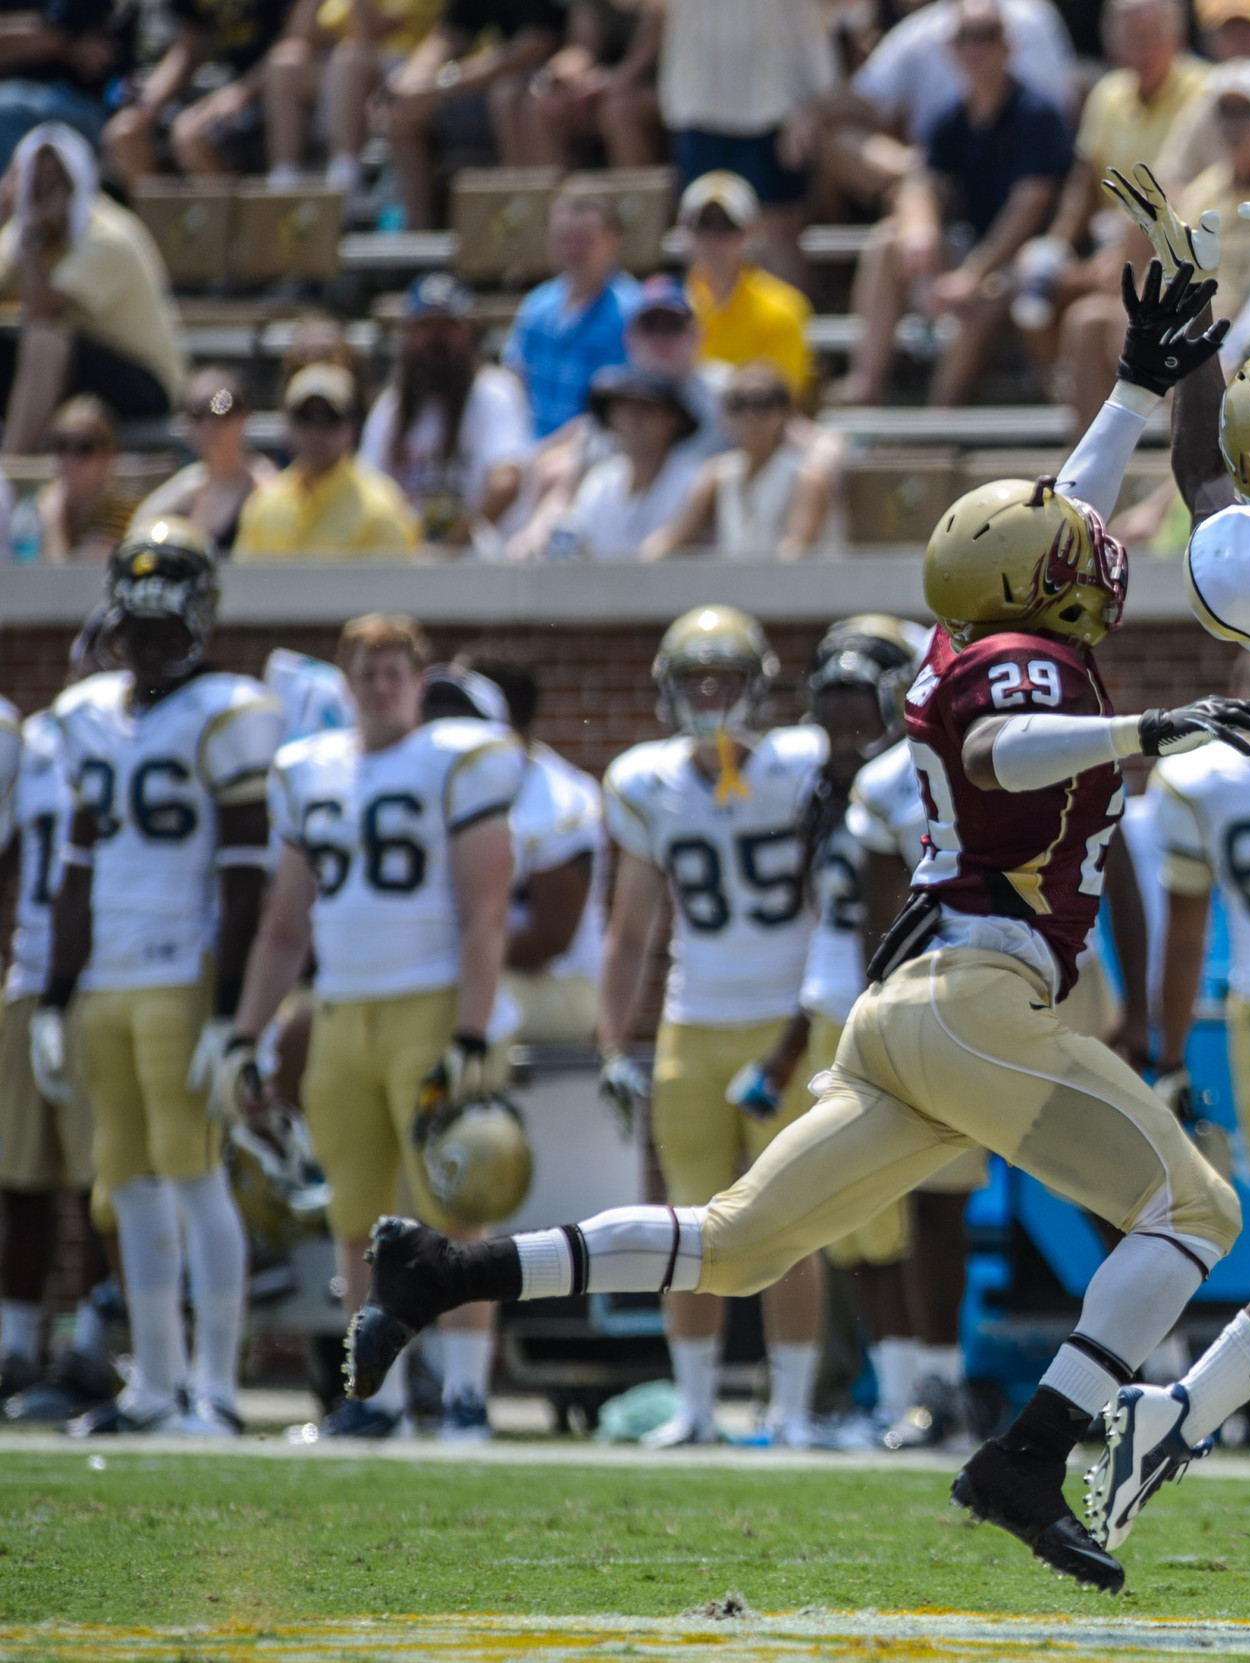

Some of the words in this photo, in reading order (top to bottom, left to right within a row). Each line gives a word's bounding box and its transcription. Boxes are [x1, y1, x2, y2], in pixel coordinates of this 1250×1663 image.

[987, 658, 1062, 710] 29
[302, 794, 428, 893] 66
[669, 826, 806, 930] 85
